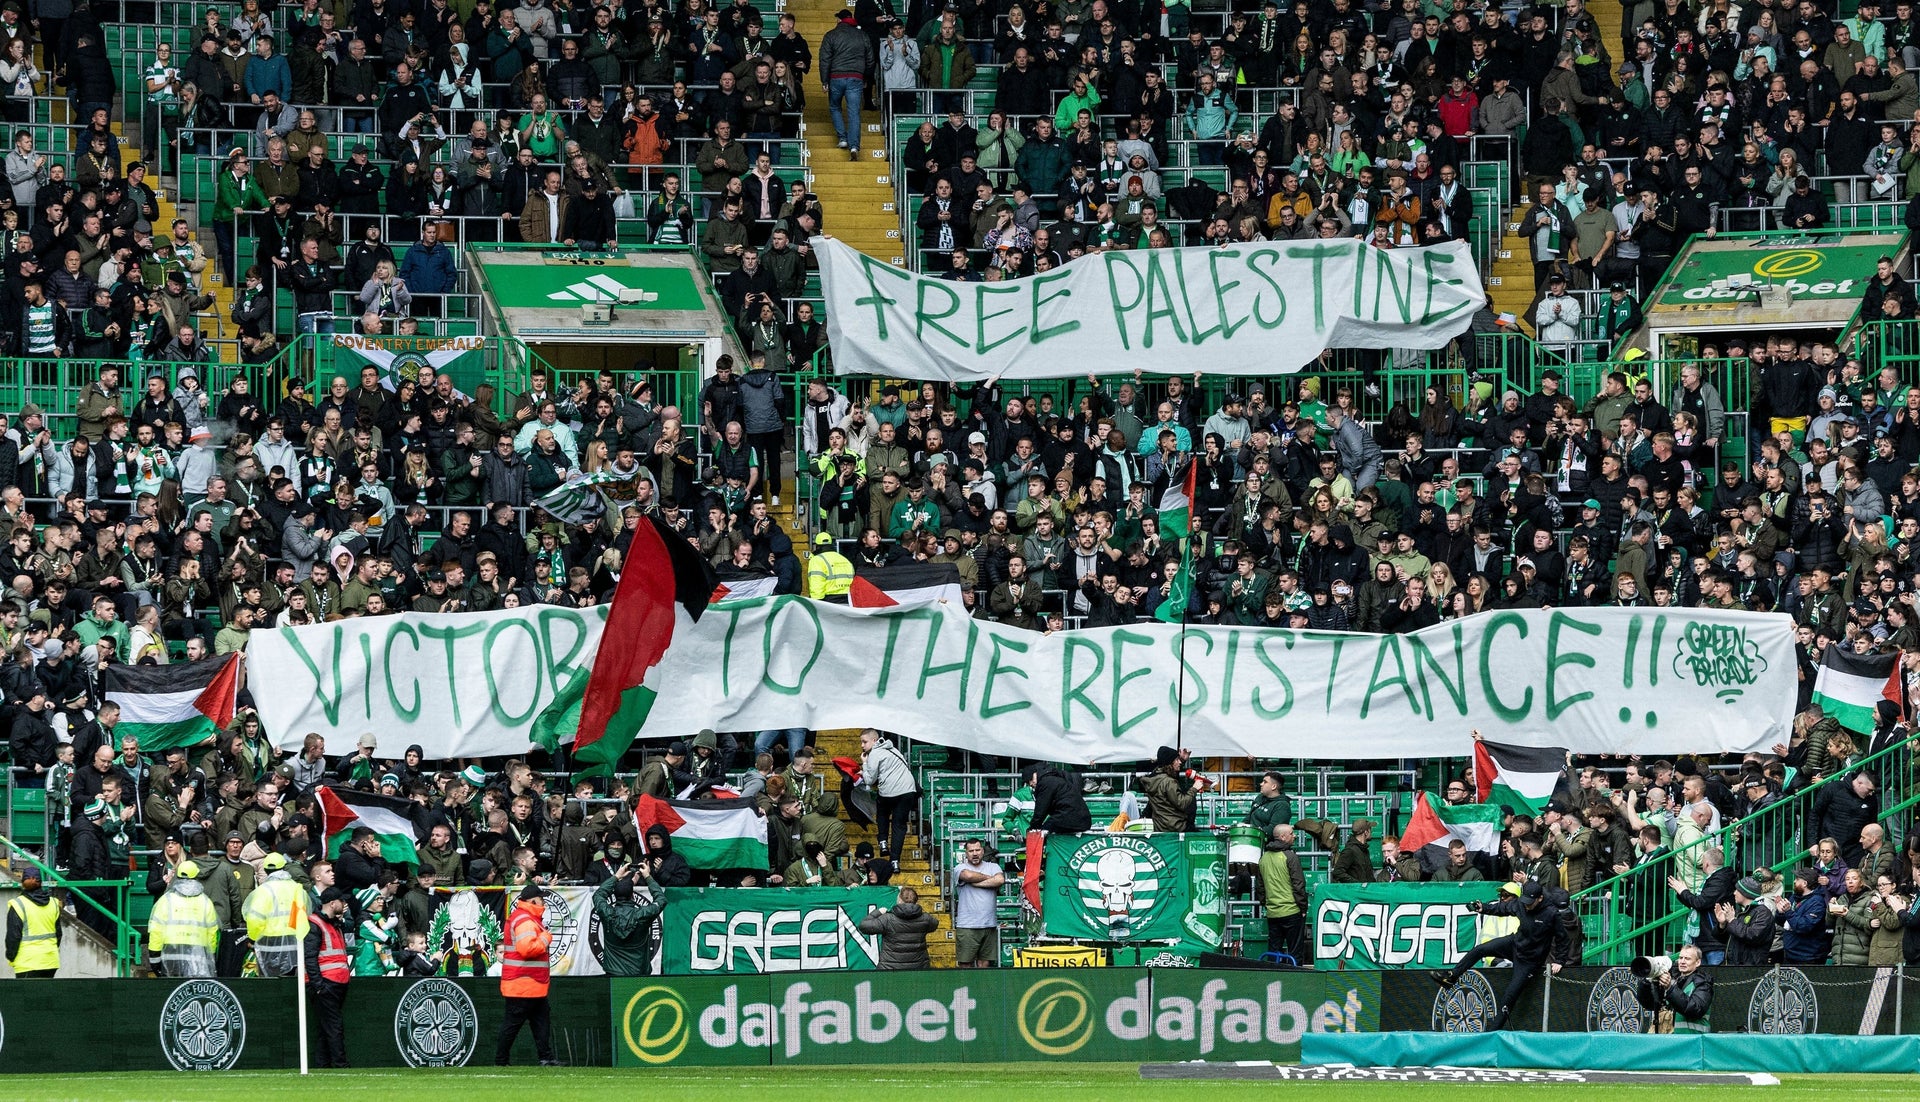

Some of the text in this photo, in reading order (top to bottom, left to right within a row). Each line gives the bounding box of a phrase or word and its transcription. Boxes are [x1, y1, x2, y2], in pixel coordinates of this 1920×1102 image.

[210, 274, 221, 282] EE
[1490, 277, 1501, 285] EE
[855, 240, 1471, 356] FREE PALESTINE
[334, 334, 485, 351] COVENTRY EMERALD
[1684, 621, 1746, 657] GREEN
[281, 604, 608, 729] VICTOR
[706, 594, 825, 698] TO
[876, 607, 1033, 721] THE
[1685, 655, 1758, 687] BRIGADE
[1069, 836, 1166, 870] GREEN BRIGADE
[924, 875, 932, 883] G
[935, 902, 942, 910] F
[590, 920, 599, 934] THE
[690, 904, 881, 973] GREEN
[947, 931, 954, 939] E
[1316, 898, 1482, 965] BRIGAD
[1026, 957, 1090, 968] THIS IS A
[1153, 952, 1188, 963] JENIN
[164, 983, 241, 1031] THE CELTIC FOOTBALL CLUB
[399, 982, 474, 1028] THE CELTIC FOOTBALL CLUB
[699, 980, 977, 1058] dafabet
[1106, 977, 1363, 1054] dafabet
